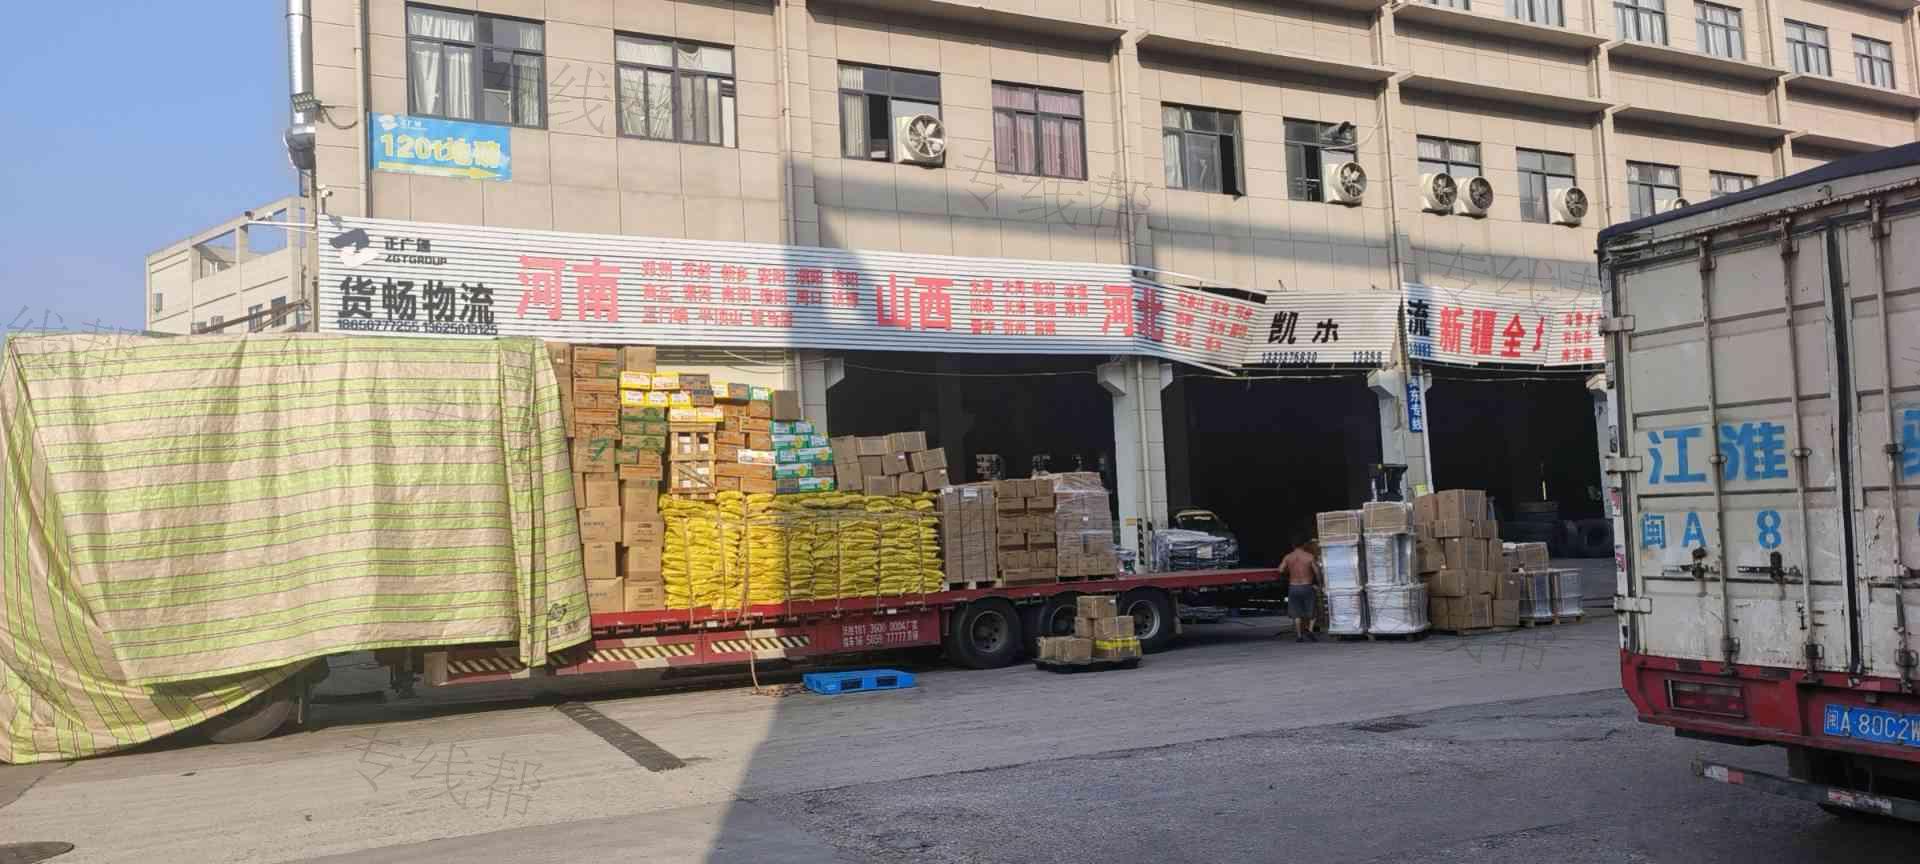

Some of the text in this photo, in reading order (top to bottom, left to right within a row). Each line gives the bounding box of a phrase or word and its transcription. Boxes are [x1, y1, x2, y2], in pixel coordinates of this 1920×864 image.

[338, 274, 494, 324] 货畅物流
[515, 254, 621, 323] 河南
[876, 272, 955, 331] 山西
[1101, 284, 1166, 343] 河北
[1439, 306, 1544, 358] 新疆全
[1647, 421, 1790, 485] 江淮
